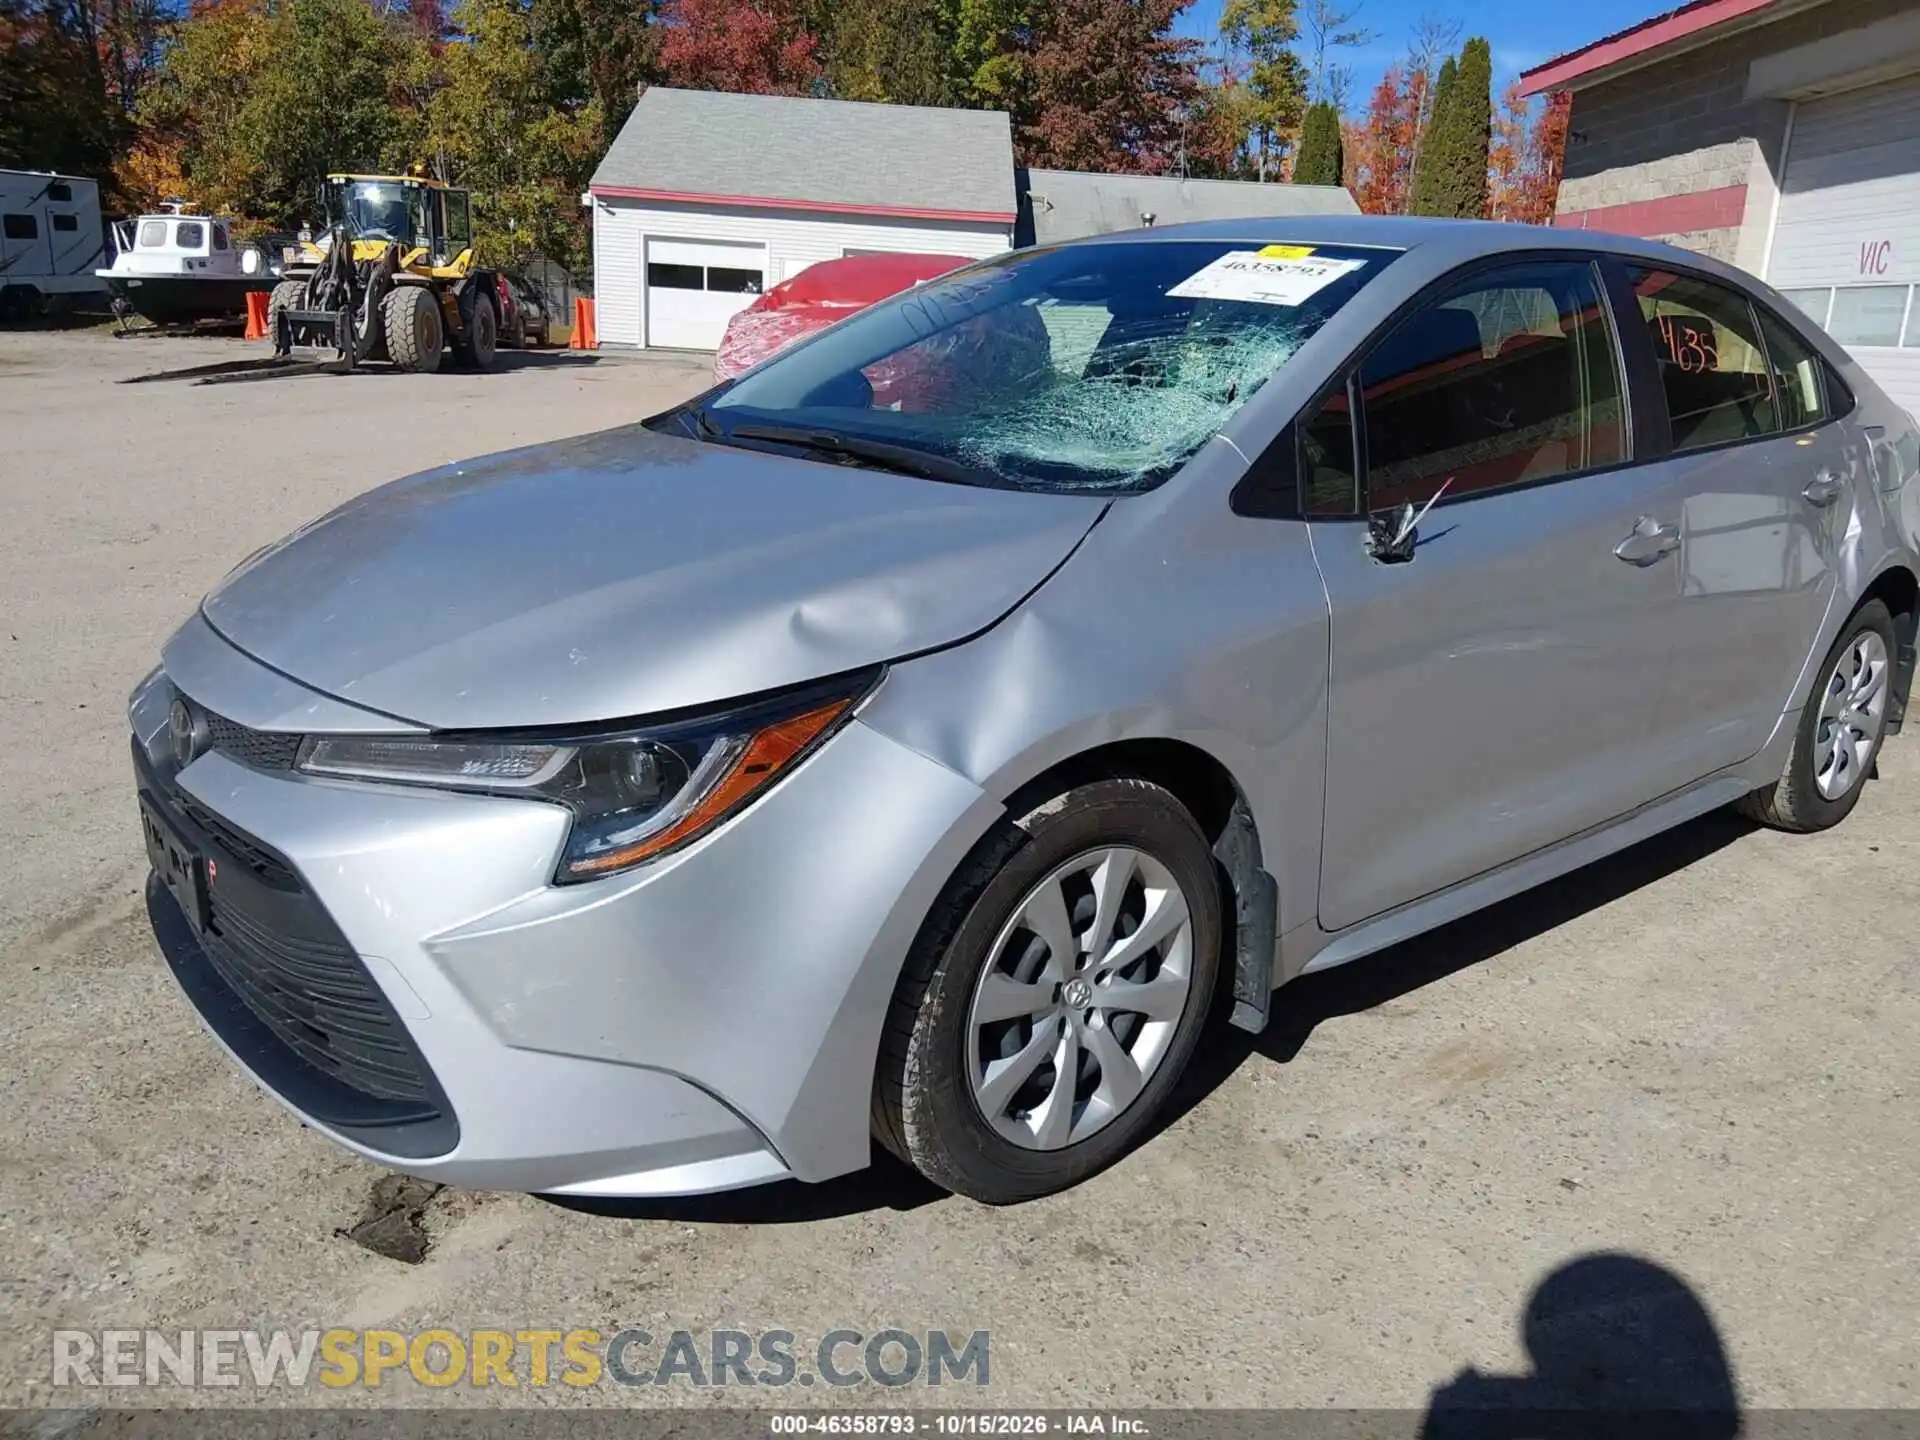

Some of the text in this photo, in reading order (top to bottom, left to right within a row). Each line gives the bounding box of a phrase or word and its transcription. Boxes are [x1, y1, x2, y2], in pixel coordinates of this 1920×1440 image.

[1222, 261, 1328, 277] 46358793
[1860, 240, 1890, 275] VIC
[1656, 307, 1720, 374] 4635
